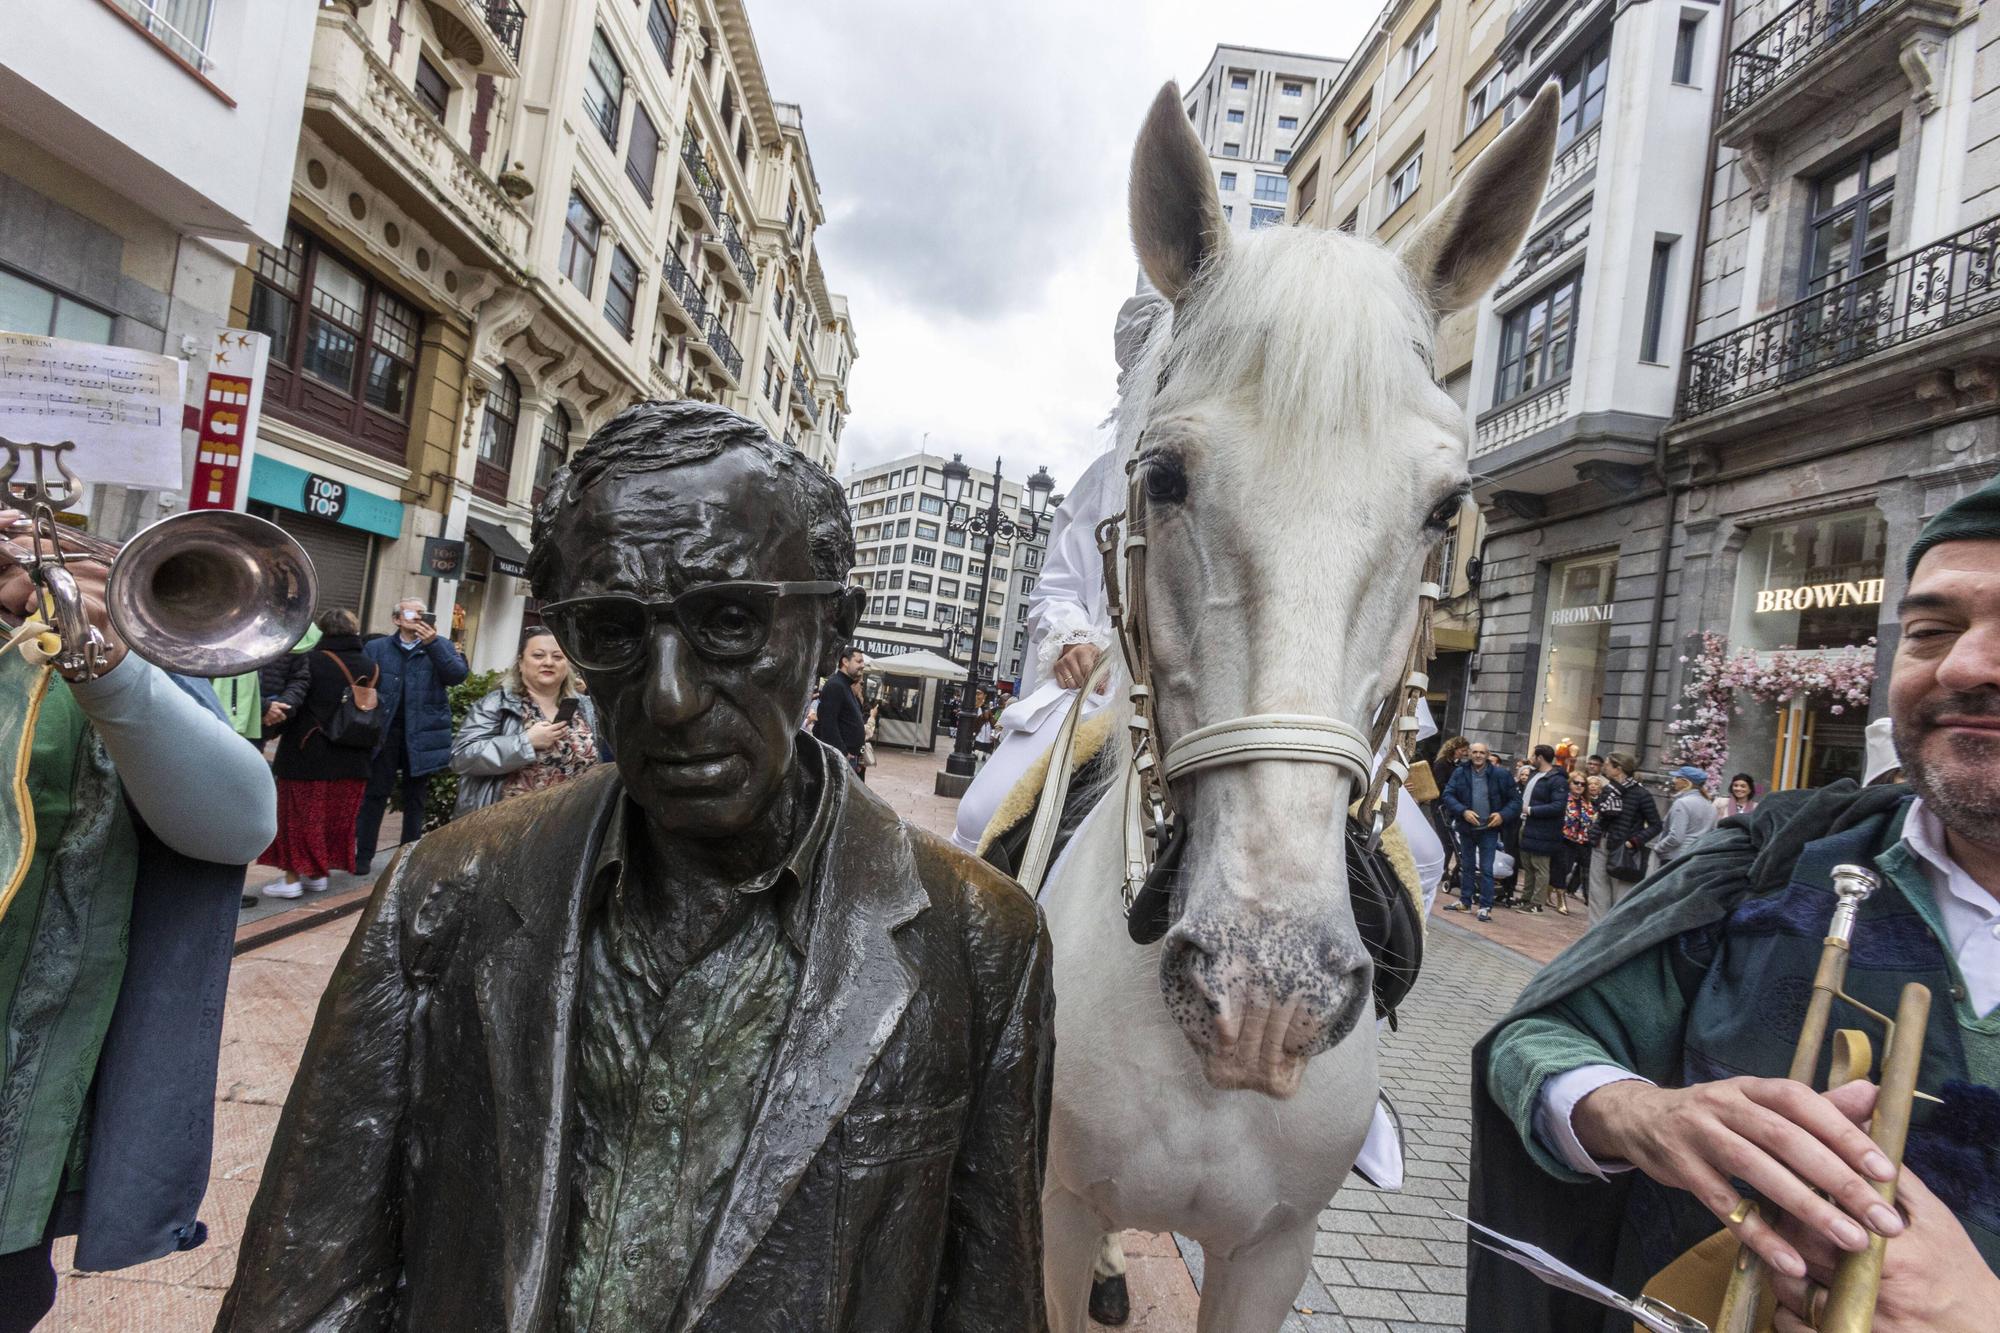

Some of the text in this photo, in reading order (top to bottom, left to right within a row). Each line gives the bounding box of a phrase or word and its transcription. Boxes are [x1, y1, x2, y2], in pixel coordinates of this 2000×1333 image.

[22, 339, 52, 348] DEUM
[313, 477, 342, 500] TOP
[309, 495, 339, 516] TOP
[433, 547, 456, 559] TOP
[432, 559, 456, 571] TOP
